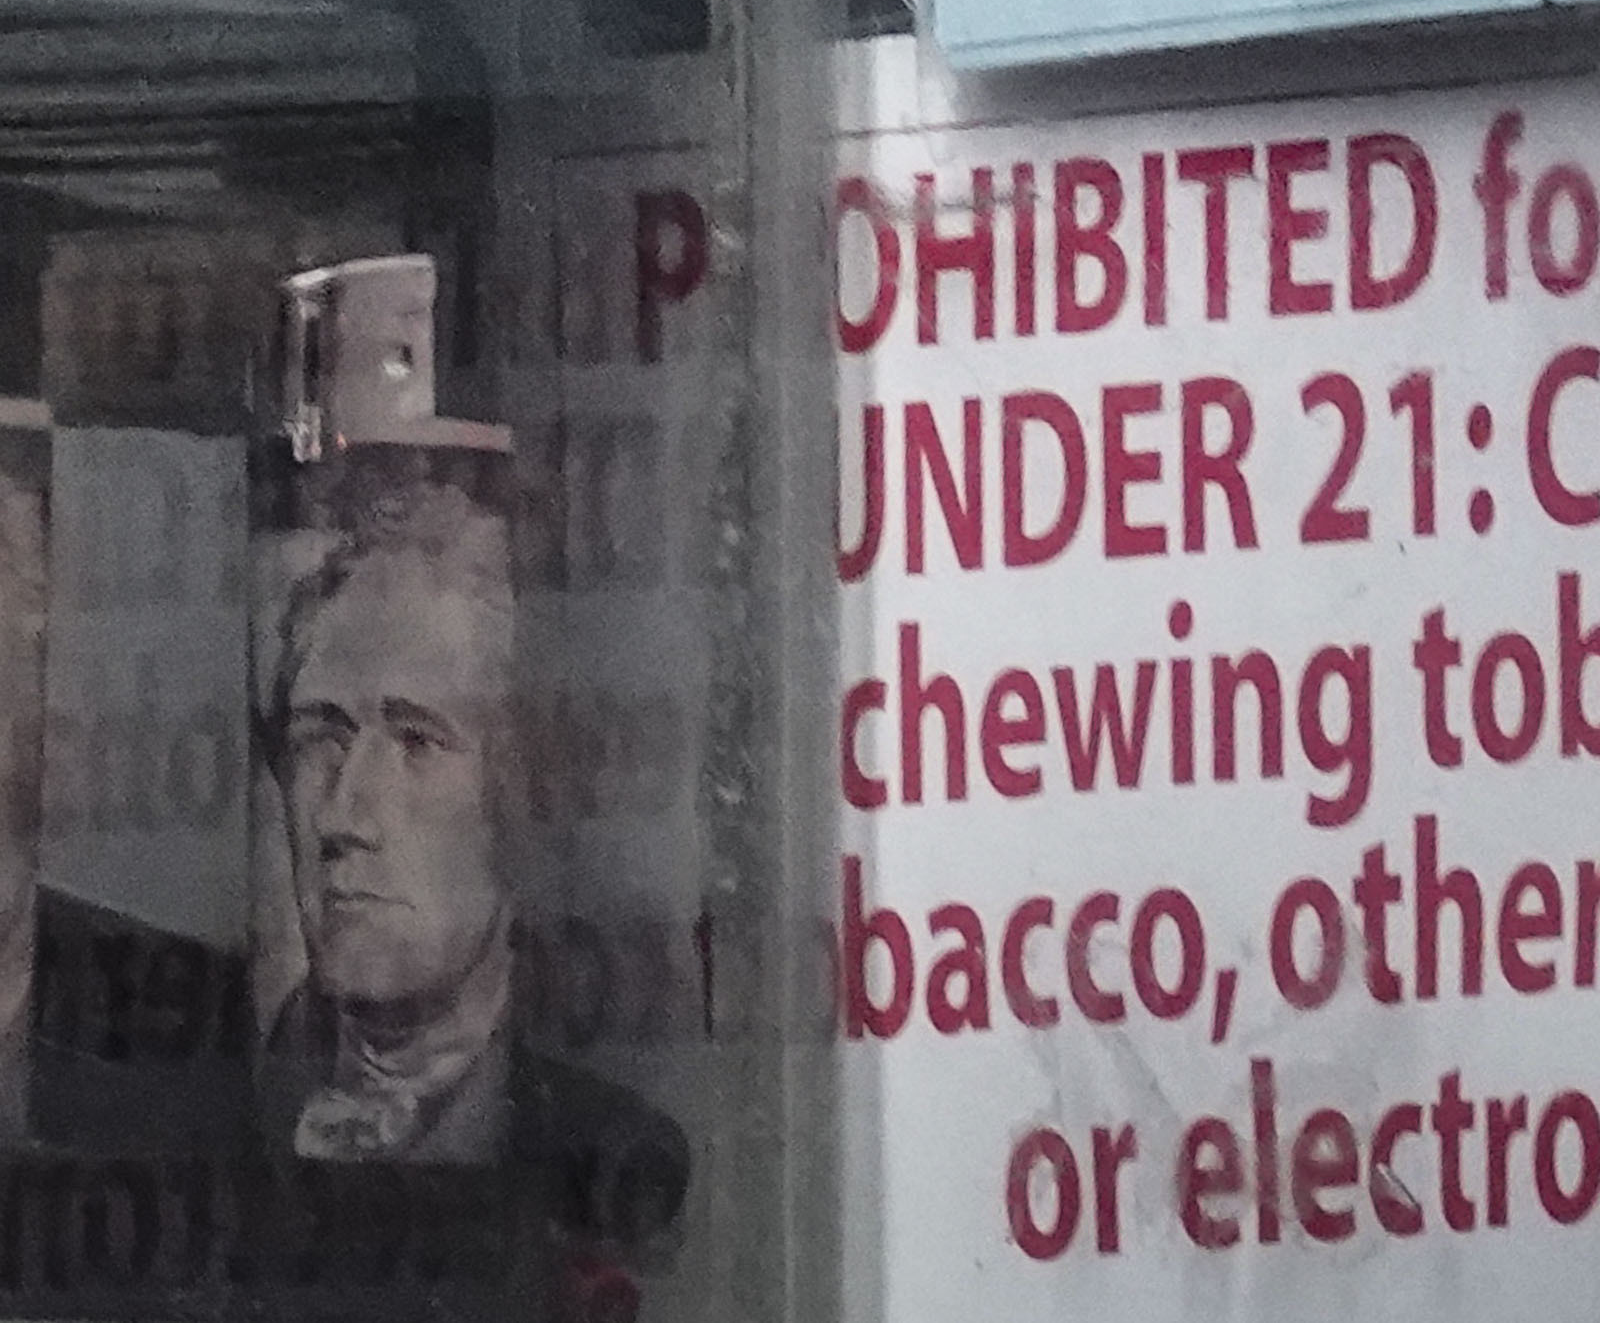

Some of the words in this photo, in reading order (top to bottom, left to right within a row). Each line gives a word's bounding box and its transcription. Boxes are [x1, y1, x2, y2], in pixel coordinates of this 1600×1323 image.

[636, 131, 1438, 363] POHIBITED
[1298, 367, 1495, 545] 21:
[836, 599, 1375, 829] chewing
[695, 854, 1238, 1046] bacco,
[1005, 1119, 1140, 1263] or
